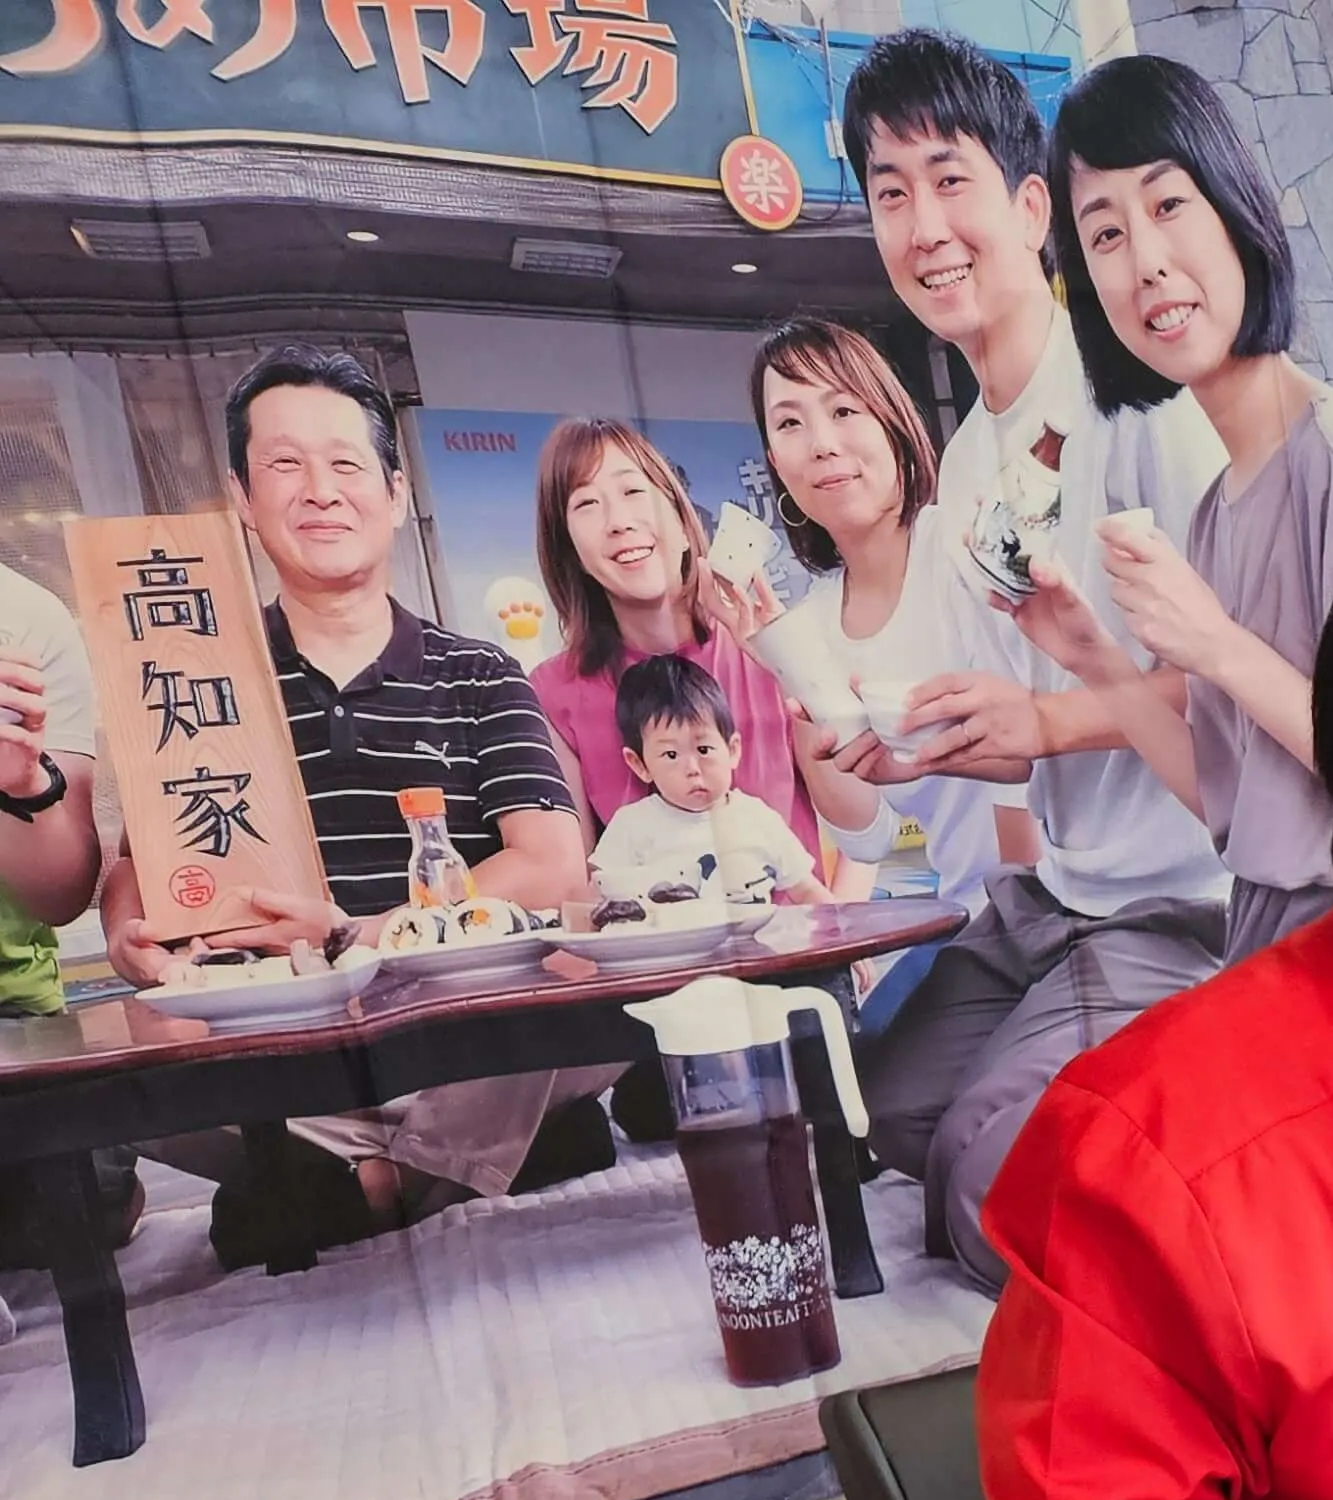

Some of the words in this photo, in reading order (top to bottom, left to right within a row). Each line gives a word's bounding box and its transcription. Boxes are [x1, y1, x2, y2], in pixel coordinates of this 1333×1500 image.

[732, 155, 790, 217] 楽
[443, 431, 517, 453] KIRIN
[116, 548, 270, 858] 高知家
